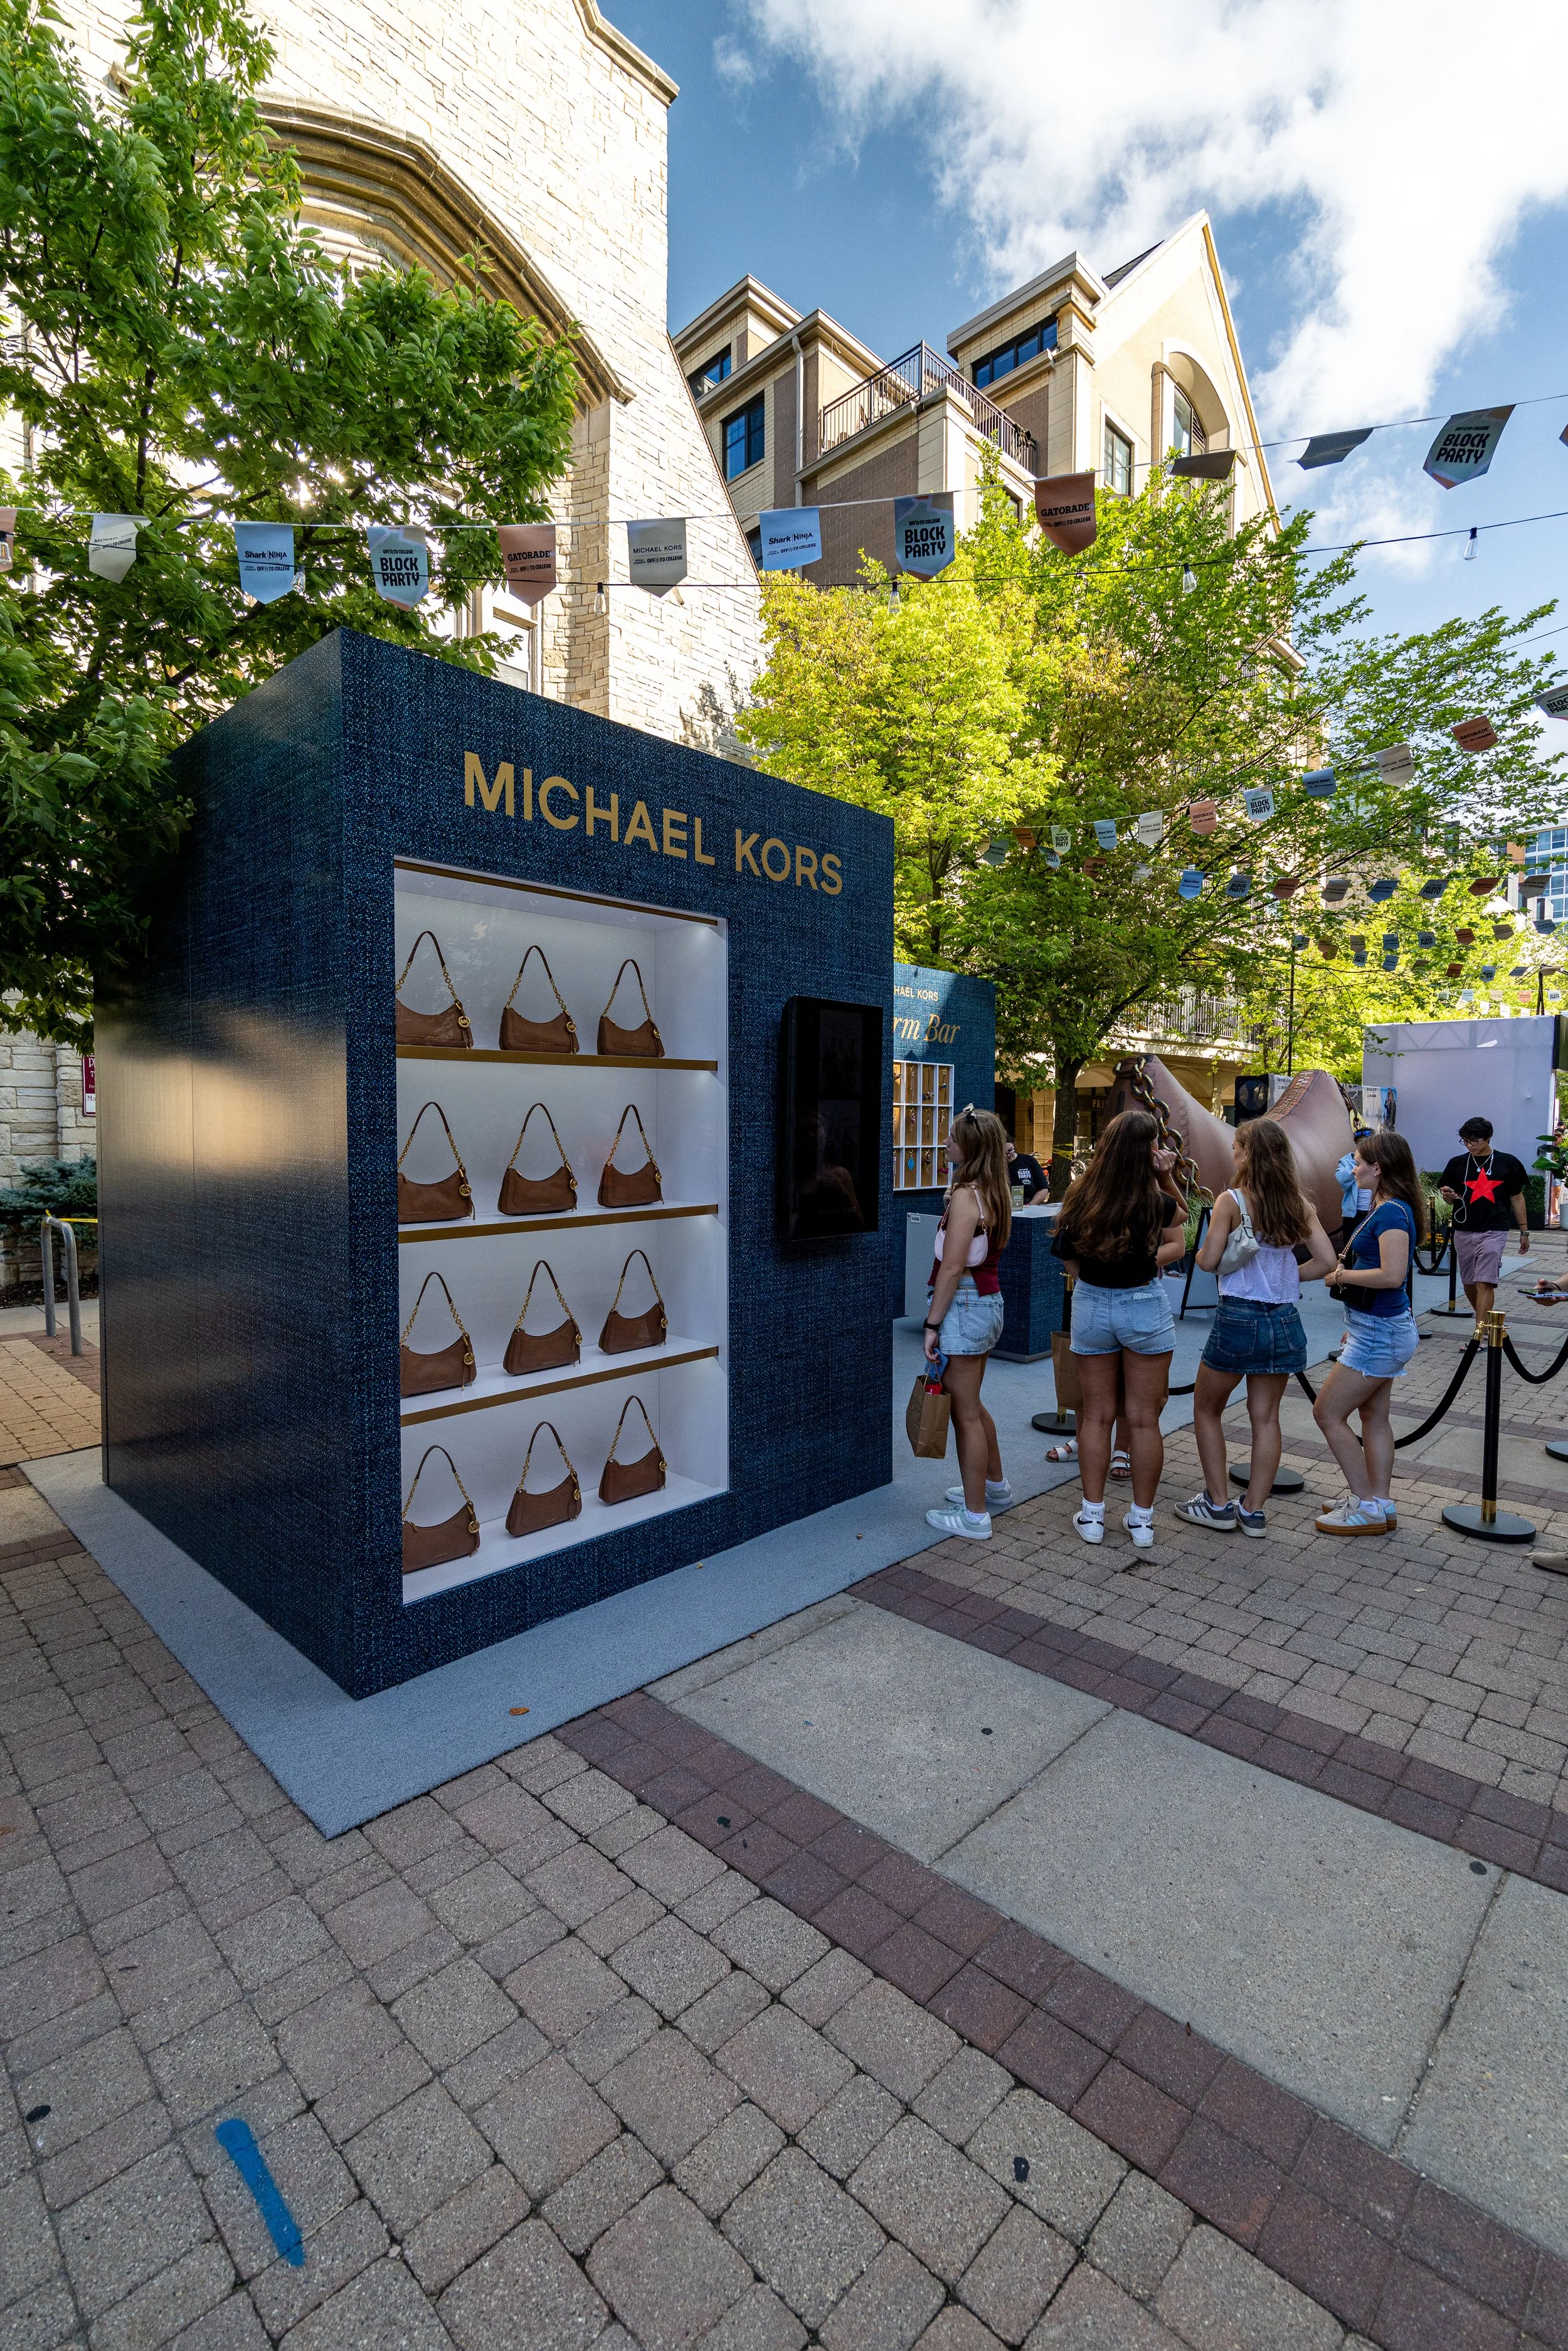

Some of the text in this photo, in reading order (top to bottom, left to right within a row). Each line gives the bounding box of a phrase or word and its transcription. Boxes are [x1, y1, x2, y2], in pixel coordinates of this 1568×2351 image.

[1442, 433, 1491, 448] BLOCK
[1435, 447, 1485, 464] PARTY
[1041, 503, 1089, 517] GATORADE
[118, 537, 132, 545] COLLEGE
[769, 535, 791, 544] Shark
[905, 526, 945, 544] BLOCK
[507, 550, 550, 562] GATORADE
[905, 540, 946, 559] PARTY
[380, 557, 419, 571] BLOCK
[382, 572, 420, 586] PARTY
[1546, 697, 1568, 708] BLOC
[1549, 703, 1568, 714] PAR
[1459, 728, 1489, 740] GATORADE
[1250, 799, 1269, 808] BLOCK
[1251, 805, 1270, 815] PARTY
[464, 751, 842, 895] MICHAEL KORS
[893, 985, 939, 1002] HAEL KORS
[893, 1014, 960, 1044] rm Bar
